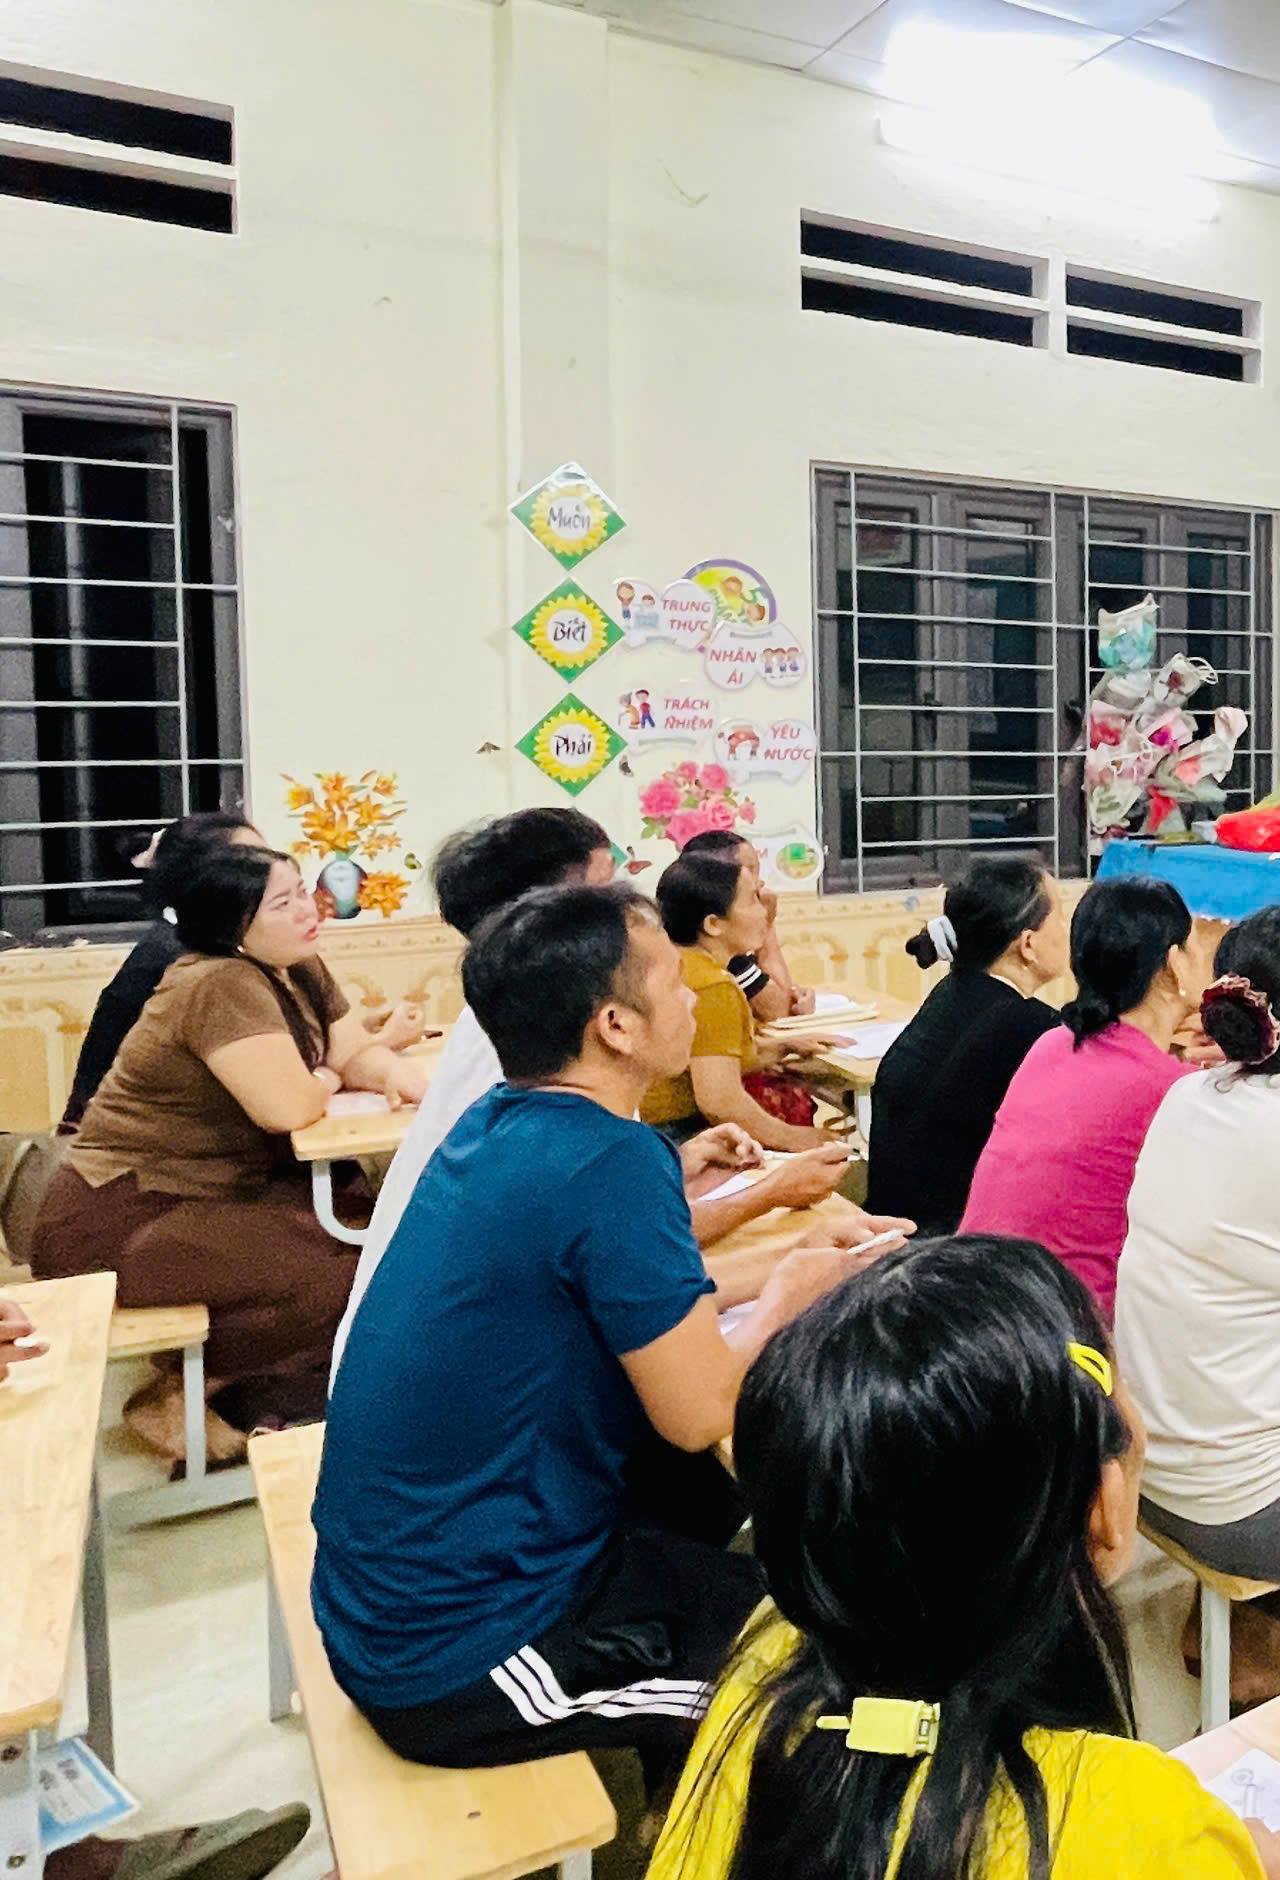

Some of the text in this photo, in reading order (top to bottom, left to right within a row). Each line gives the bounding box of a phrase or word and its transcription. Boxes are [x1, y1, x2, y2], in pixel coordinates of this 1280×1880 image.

[662, 600, 711, 612] TRUNG
[709, 647, 757, 663] NHÂN
[726, 669, 743, 684] ÁI
[663, 698, 710, 710] TRÁCH
